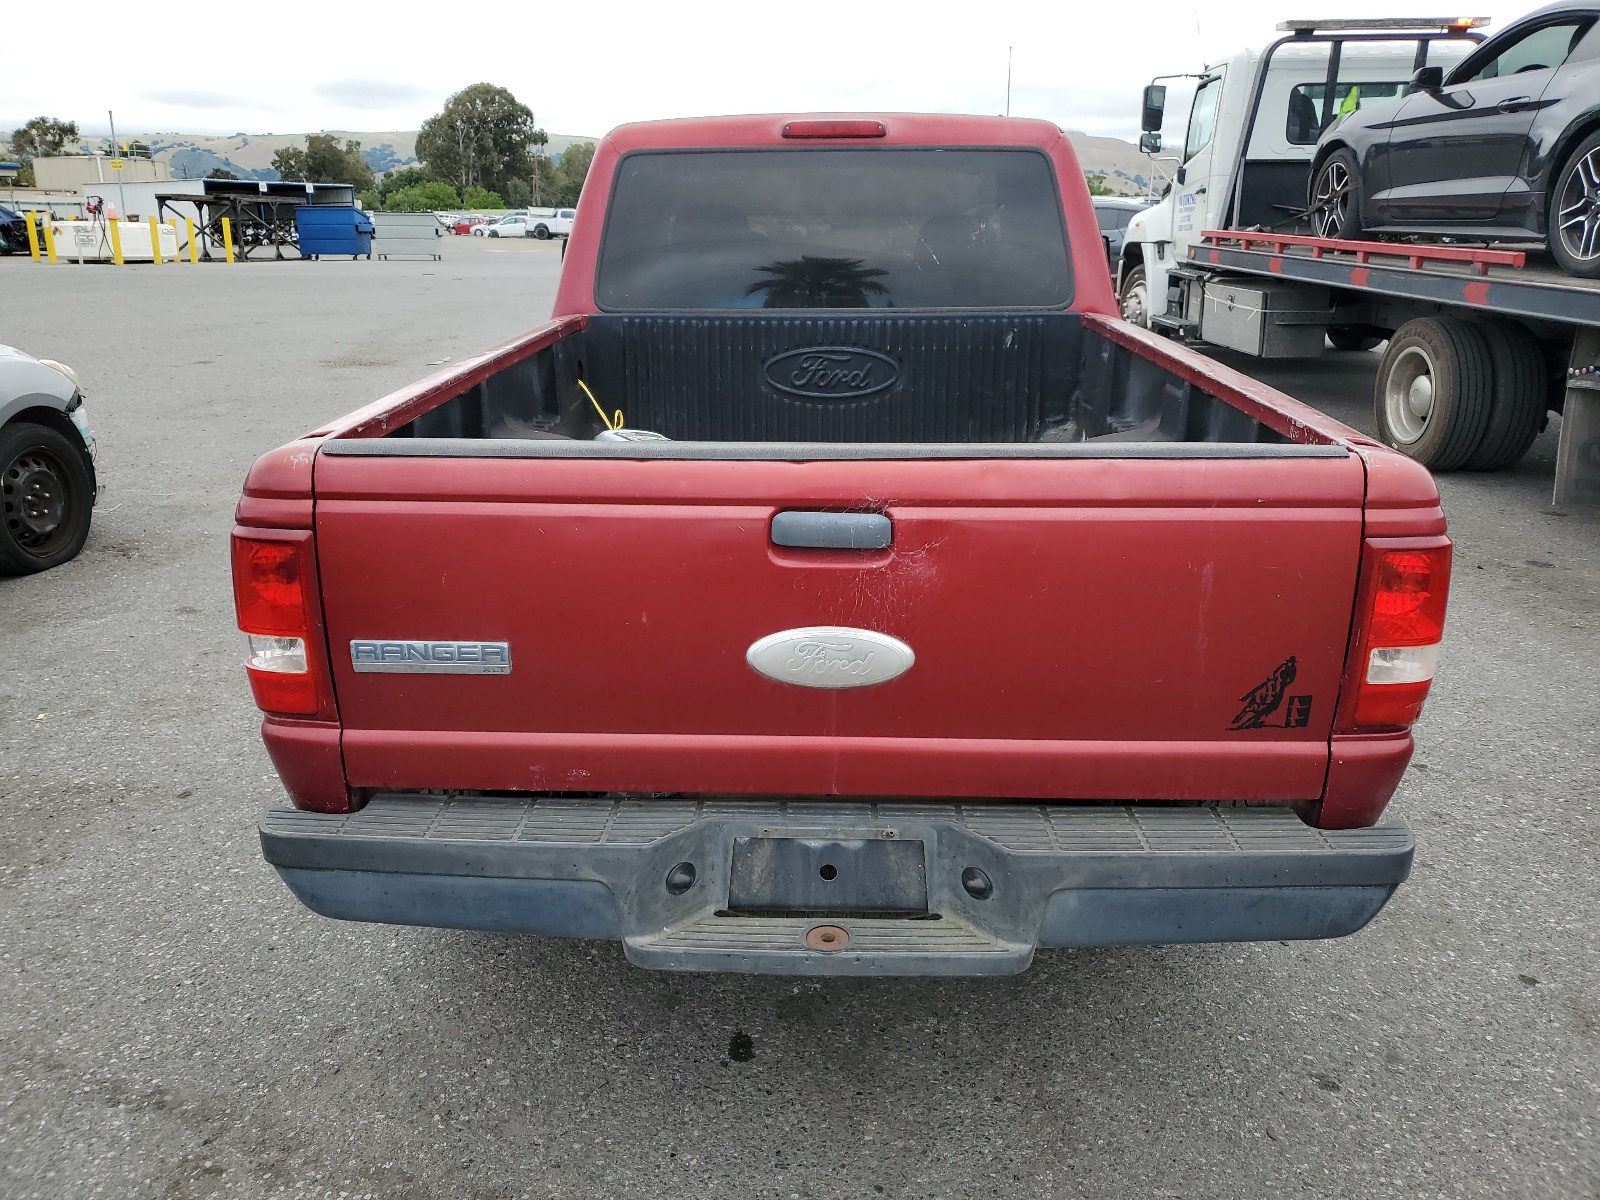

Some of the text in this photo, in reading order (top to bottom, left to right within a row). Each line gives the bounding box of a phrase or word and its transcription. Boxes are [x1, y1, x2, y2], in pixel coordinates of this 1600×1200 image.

[790, 353, 872, 388] Ford
[352, 642, 507, 662] RANGER
[785, 641, 875, 676] Ford
